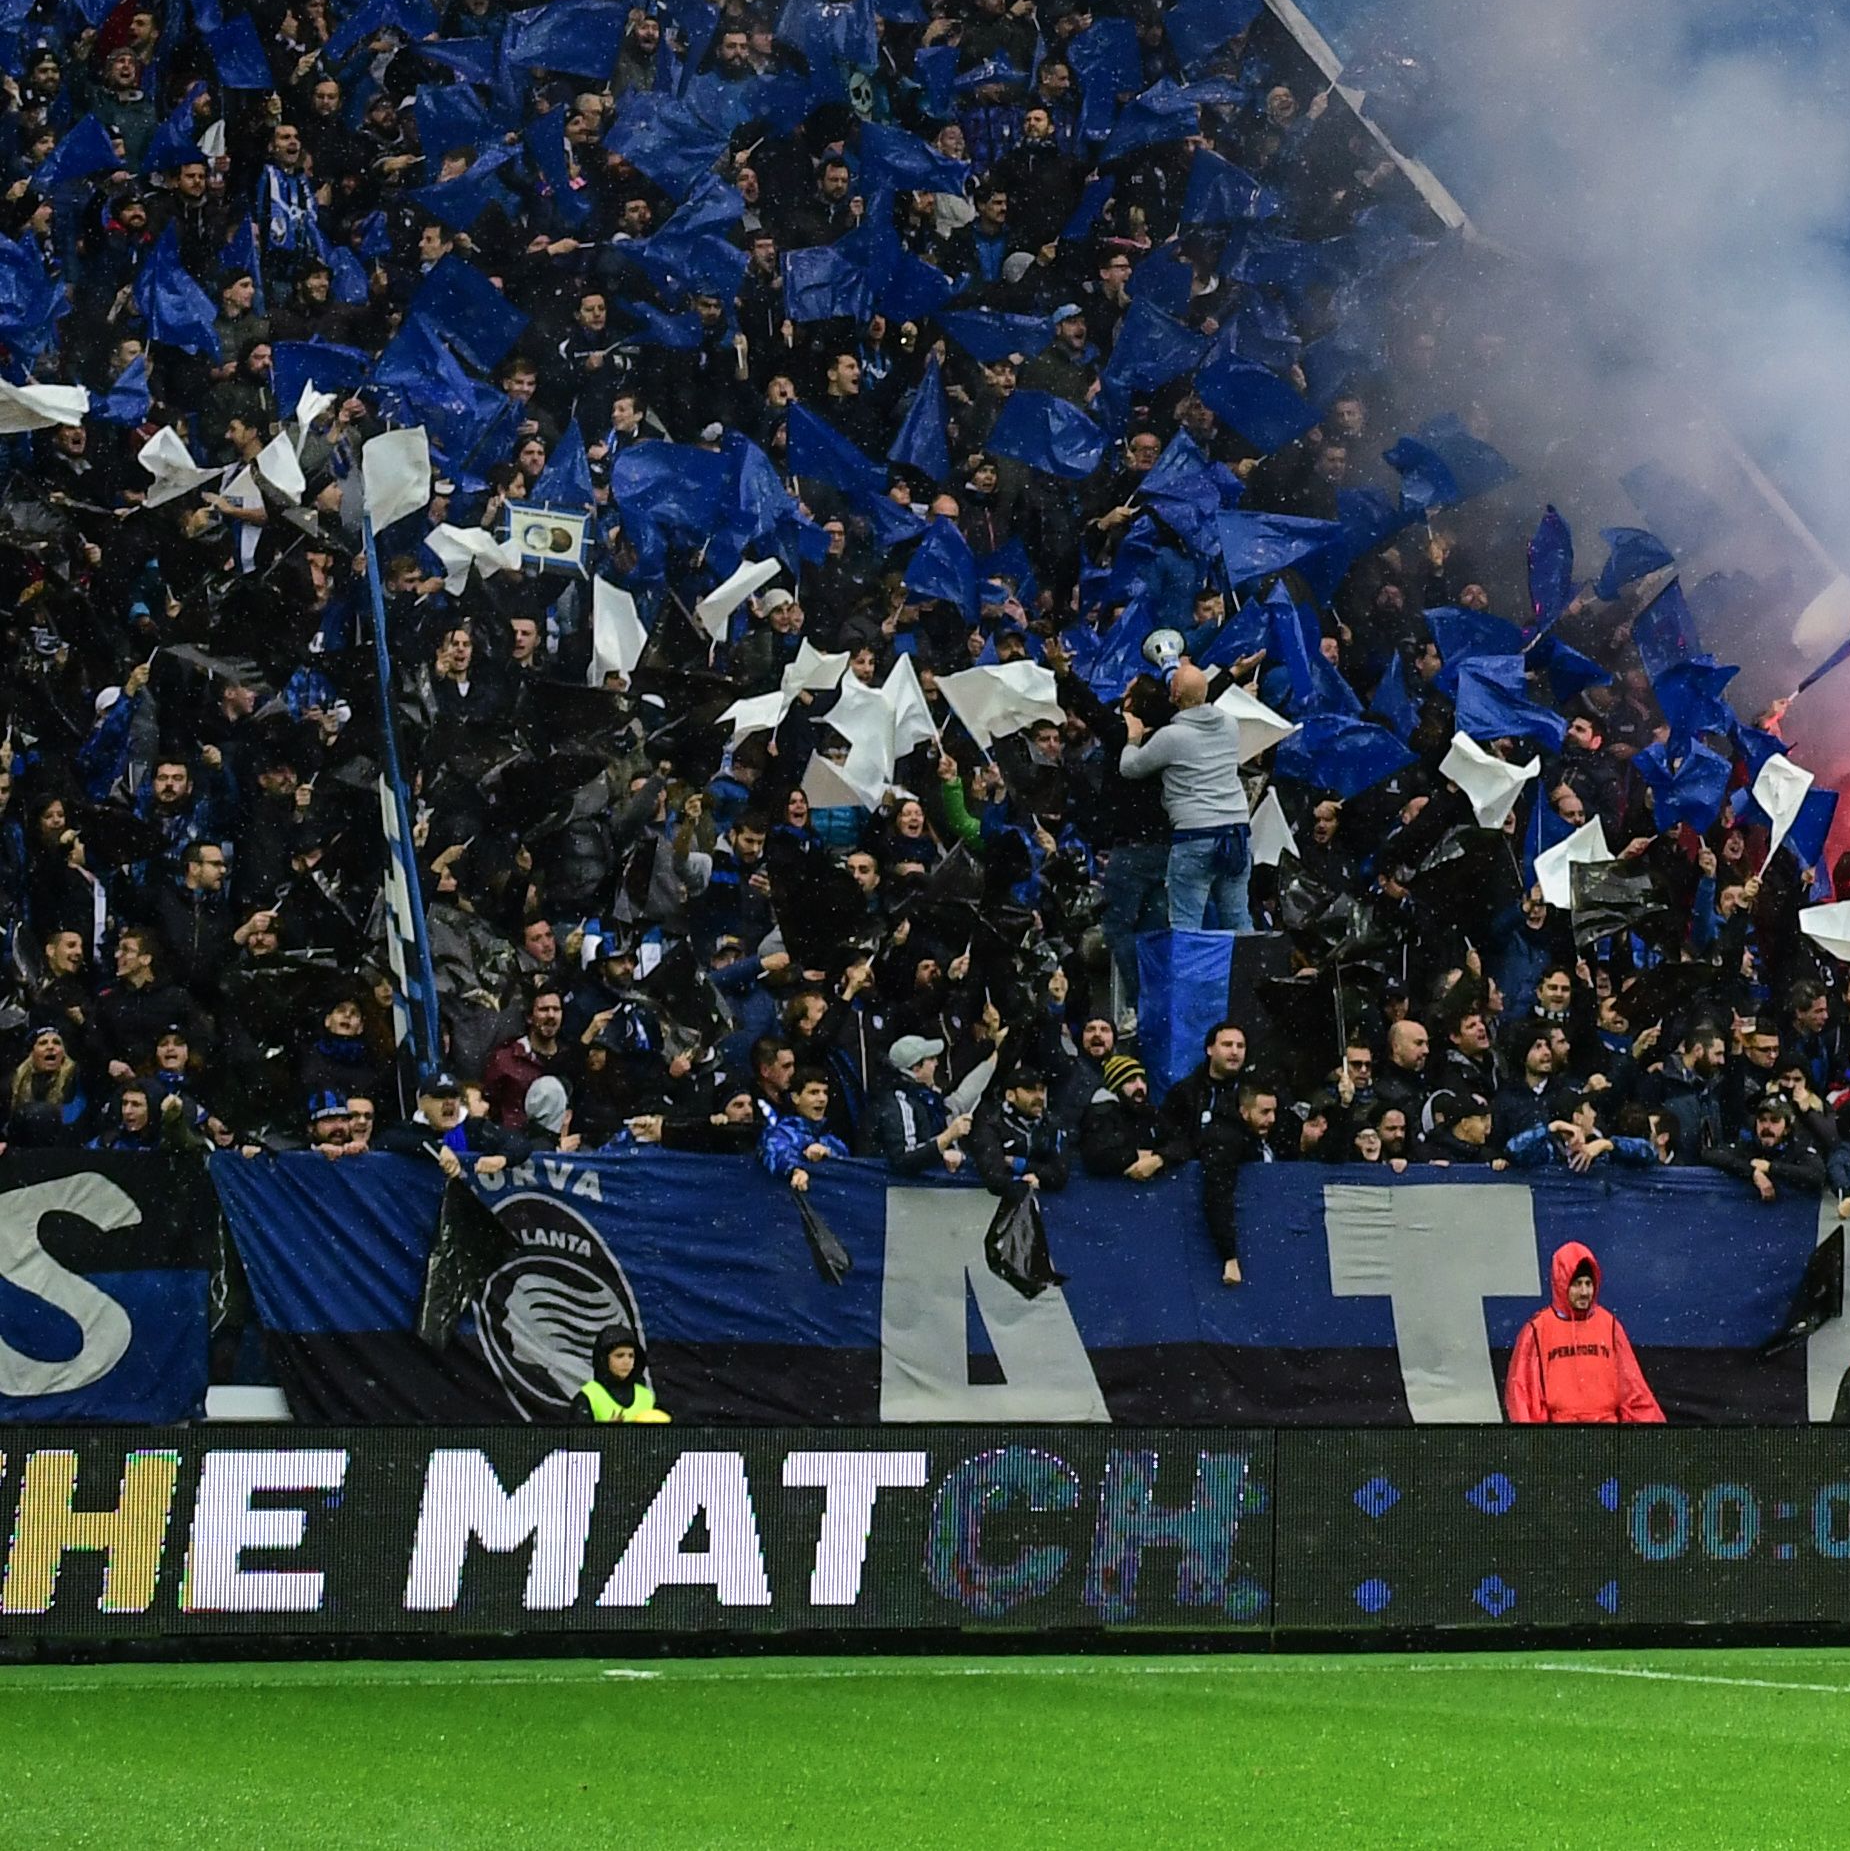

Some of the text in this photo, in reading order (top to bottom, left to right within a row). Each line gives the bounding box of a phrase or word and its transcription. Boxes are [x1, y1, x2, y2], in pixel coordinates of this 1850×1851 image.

[458, 1157, 603, 1203] URVA
[511, 1227, 593, 1258] LANTA
[0, 1445, 1250, 1614] HE MATCH
